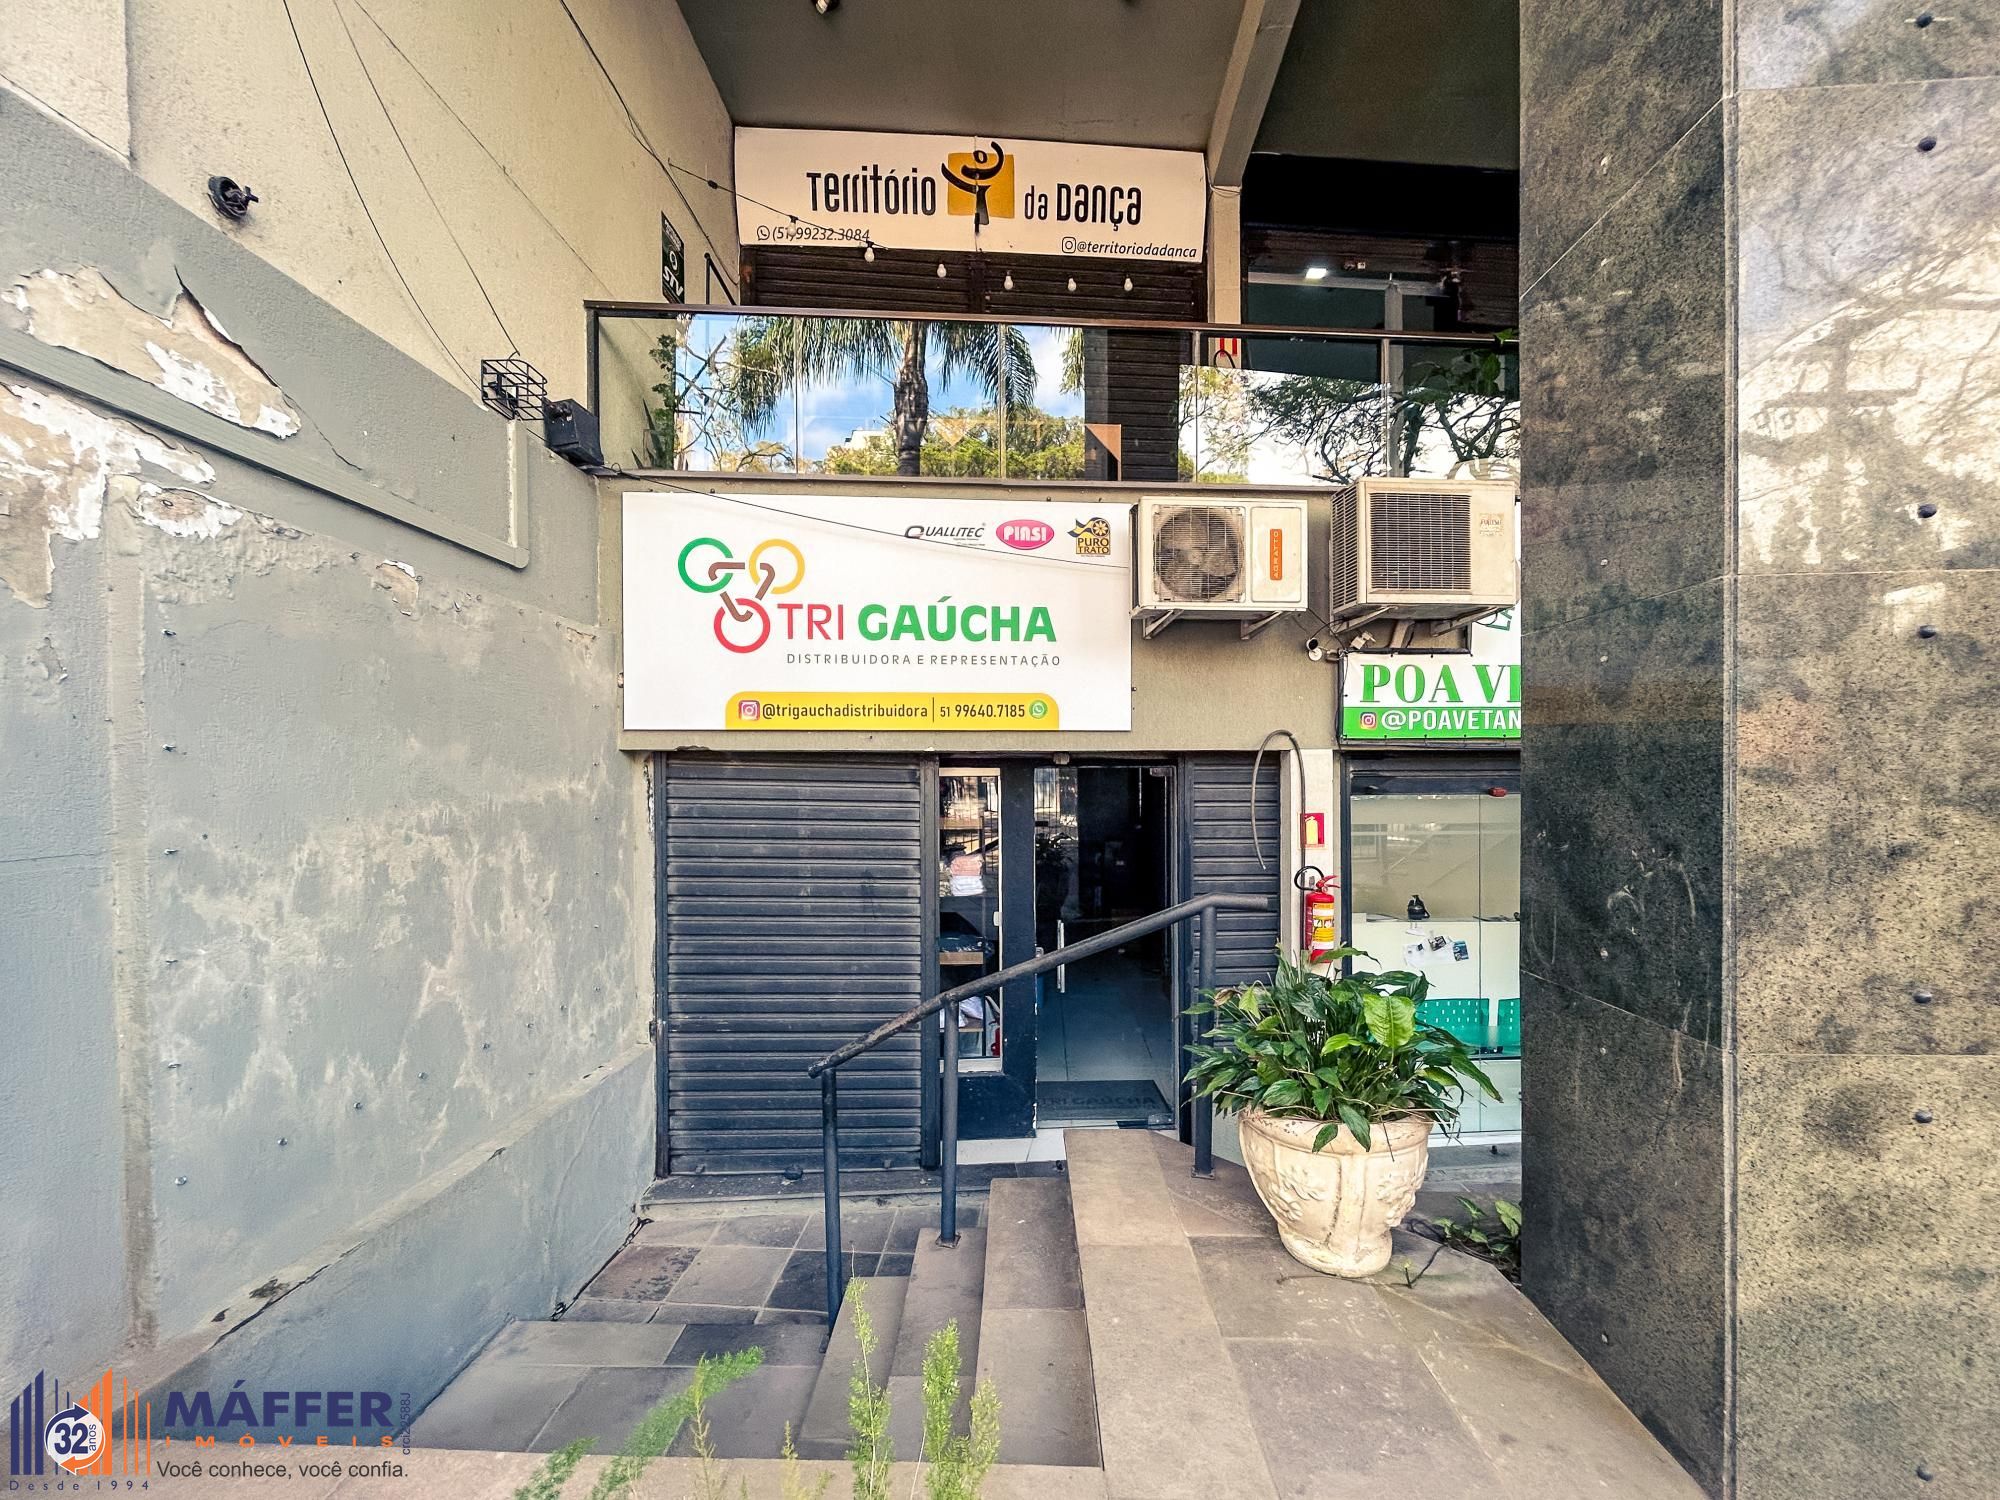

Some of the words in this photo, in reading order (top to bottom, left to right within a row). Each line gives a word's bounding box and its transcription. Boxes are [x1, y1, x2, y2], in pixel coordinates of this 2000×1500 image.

[806, 164, 936, 216] Território
[1024, 185, 1048, 221] da
[1056, 183, 1142, 232] Dança
[1077, 241, 1197, 258] @territoriodadanca
[663, 266, 684, 296] STV
[904, 525, 984, 540] QUALLITEC
[1004, 525, 1047, 542] PINSI
[1077, 537, 1109, 547] PURO
[1078, 546, 1109, 554] TRATO
[777, 603, 844, 641] TRI
[858, 595, 1057, 642] GAÚCHA
[787, 653, 911, 665] DISTRIBUIDORA
[917, 655, 924, 665] E
[930, 653, 1060, 668] REPRESENTAÇÃO
[1360, 664, 1463, 703] POA
[762, 703, 928, 720] @trigauchadistribuidora
[940, 706, 950, 718] 51
[954, 704, 1025, 718] 99640.7185
